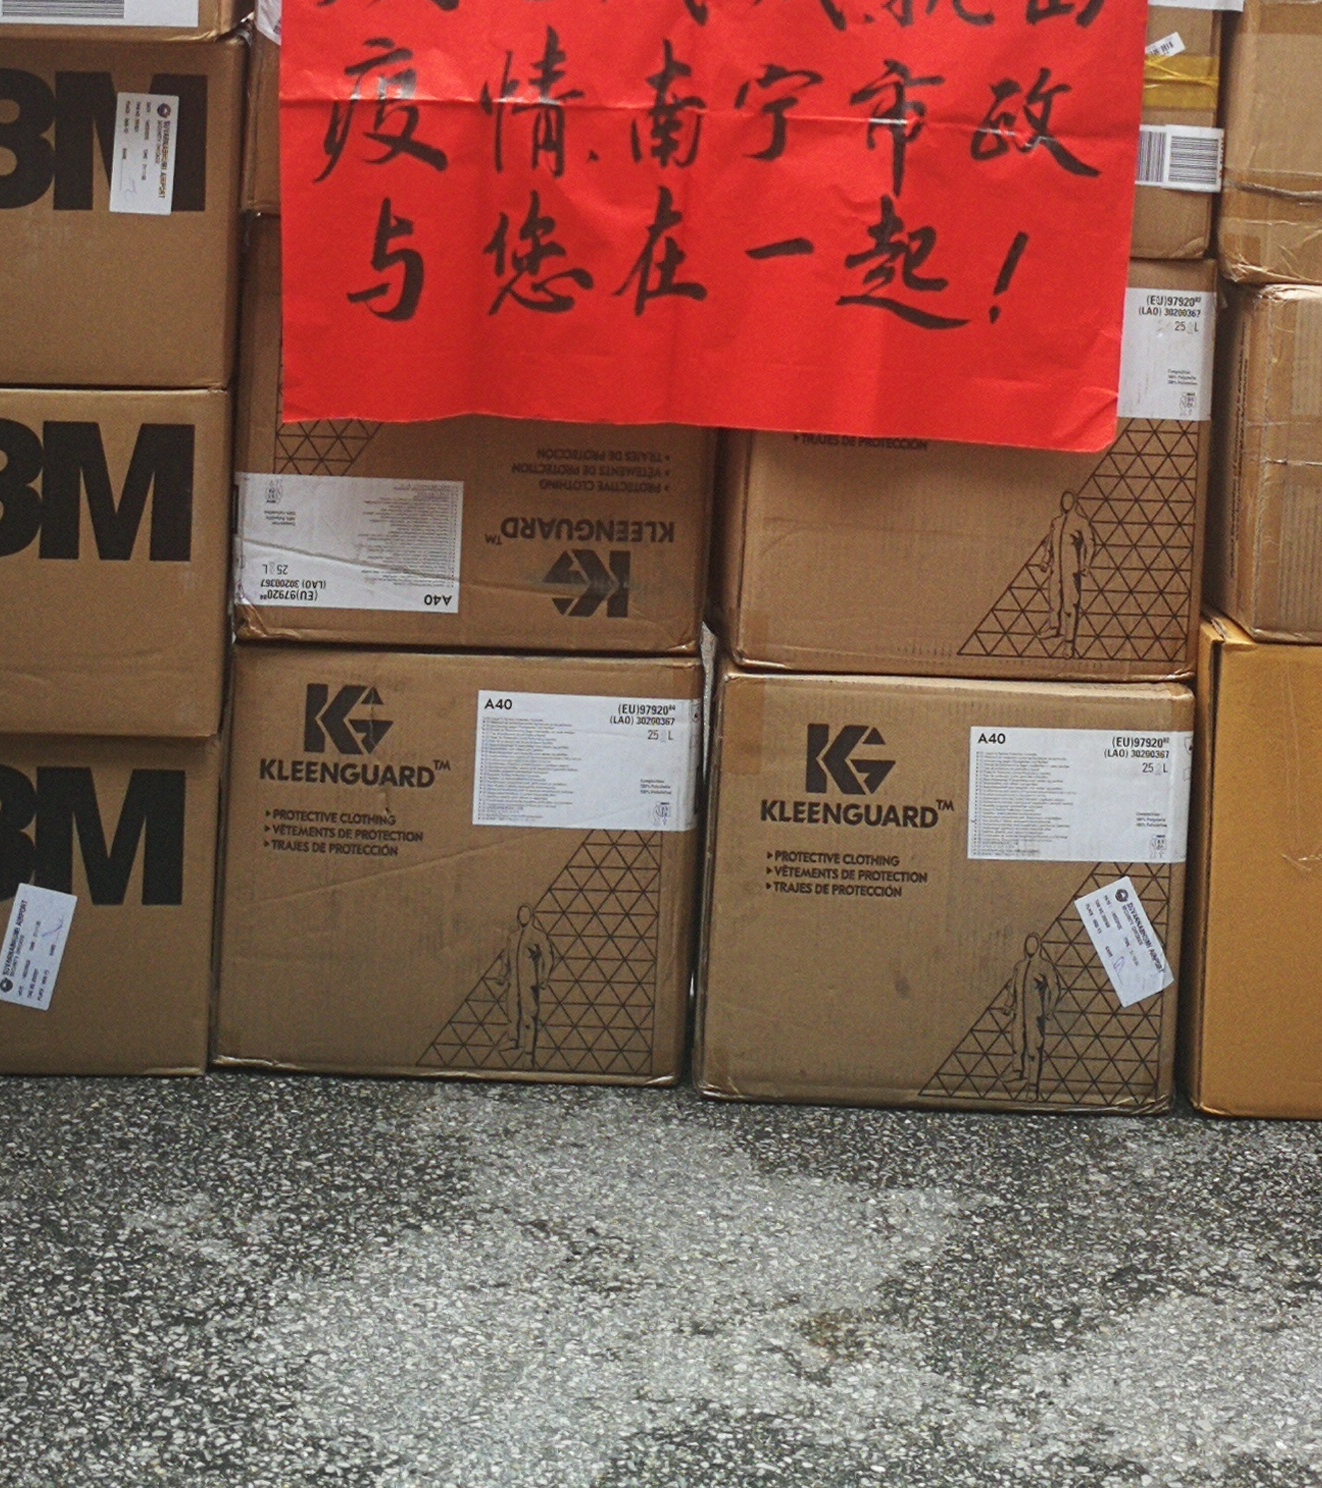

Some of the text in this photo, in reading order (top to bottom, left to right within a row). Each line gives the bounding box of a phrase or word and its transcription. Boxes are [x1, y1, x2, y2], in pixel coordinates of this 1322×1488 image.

[424, 594, 453, 606] A40
[484, 698, 513, 711] A40
[978, 733, 1006, 744] A40
